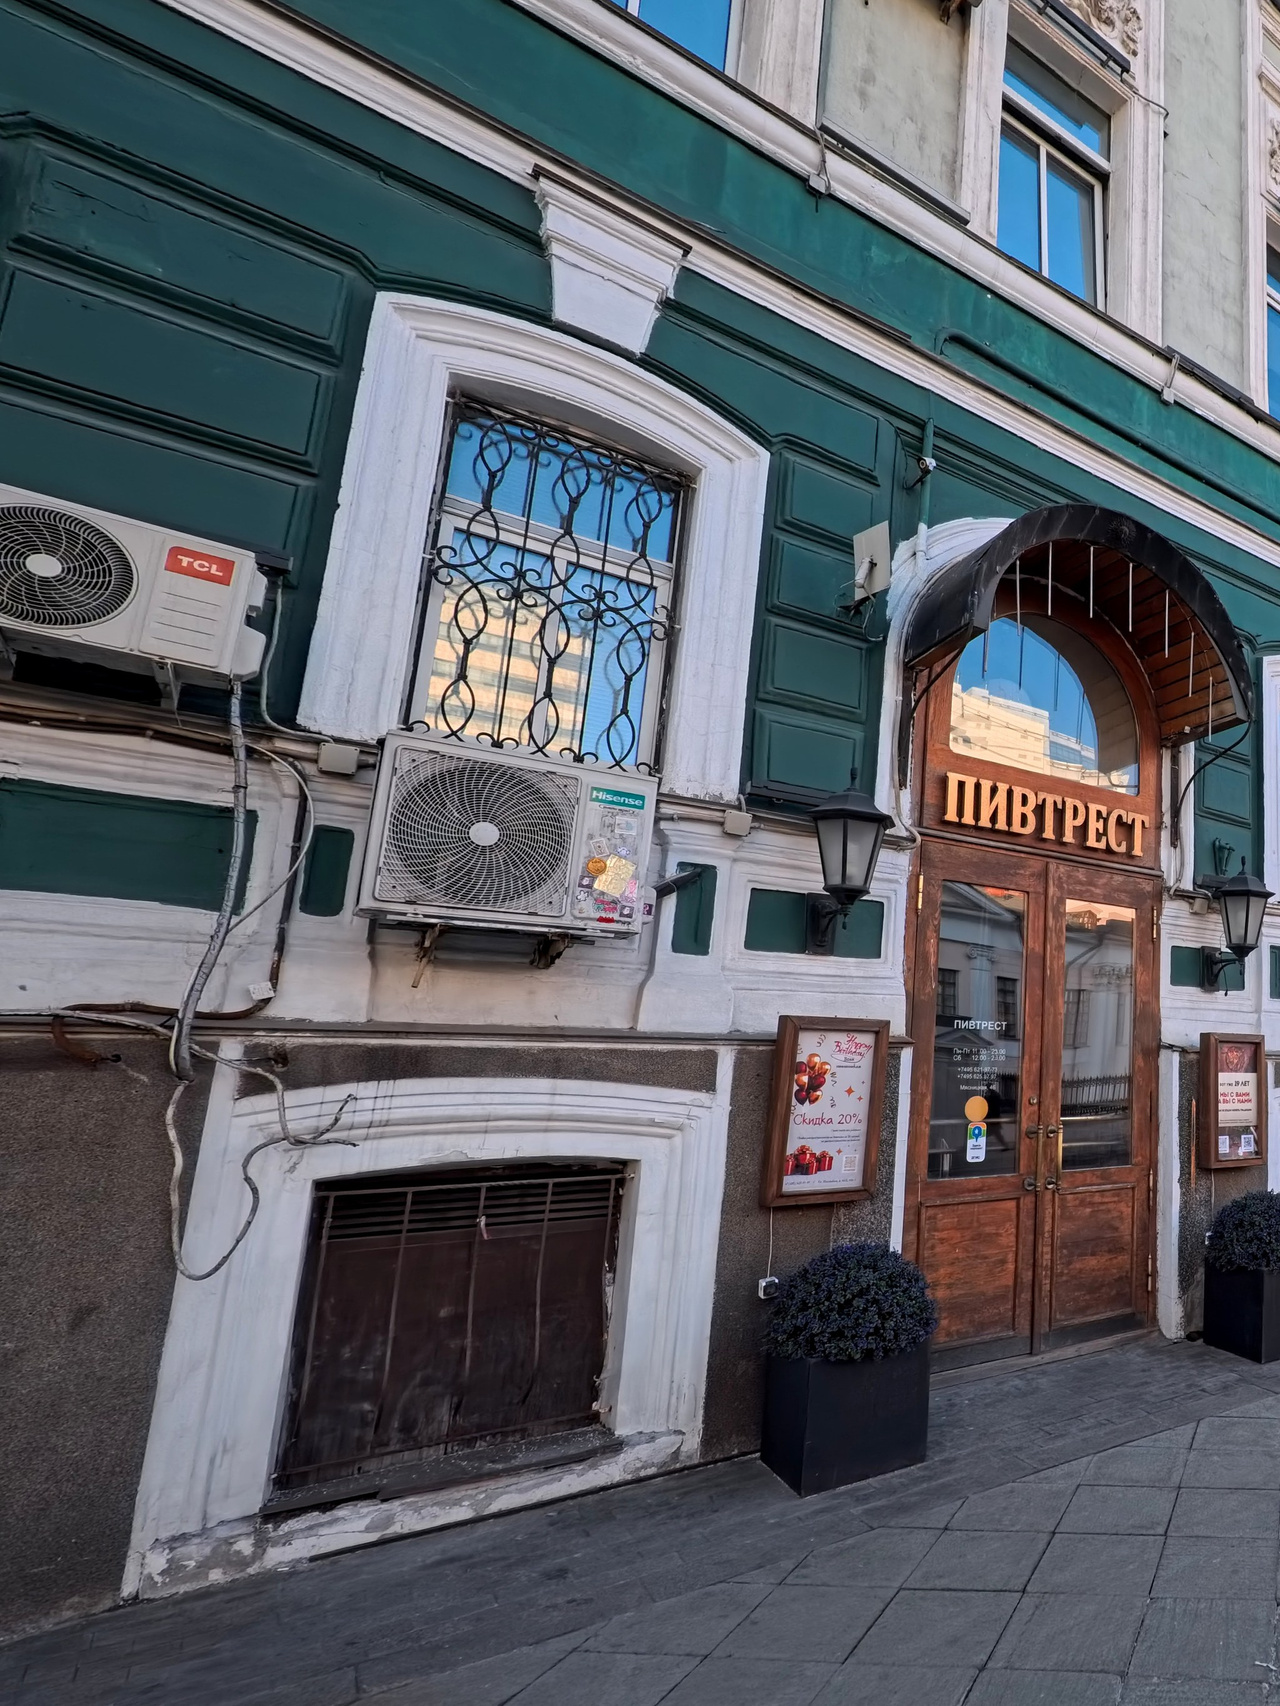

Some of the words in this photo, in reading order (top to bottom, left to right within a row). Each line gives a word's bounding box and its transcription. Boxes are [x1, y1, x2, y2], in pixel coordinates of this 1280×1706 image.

[177, 554, 224, 577] TCL
[591, 789, 644, 807] Hisense
[942, 771, 1150, 858] ПИВТРЕСТ
[953, 1019, 1008, 1031] ПИВТРЕСТ
[844, 1032, 873, 1052] Happy
[793, 1111, 834, 1126] Скидка
[837, 1112, 863, 1125] 20%
